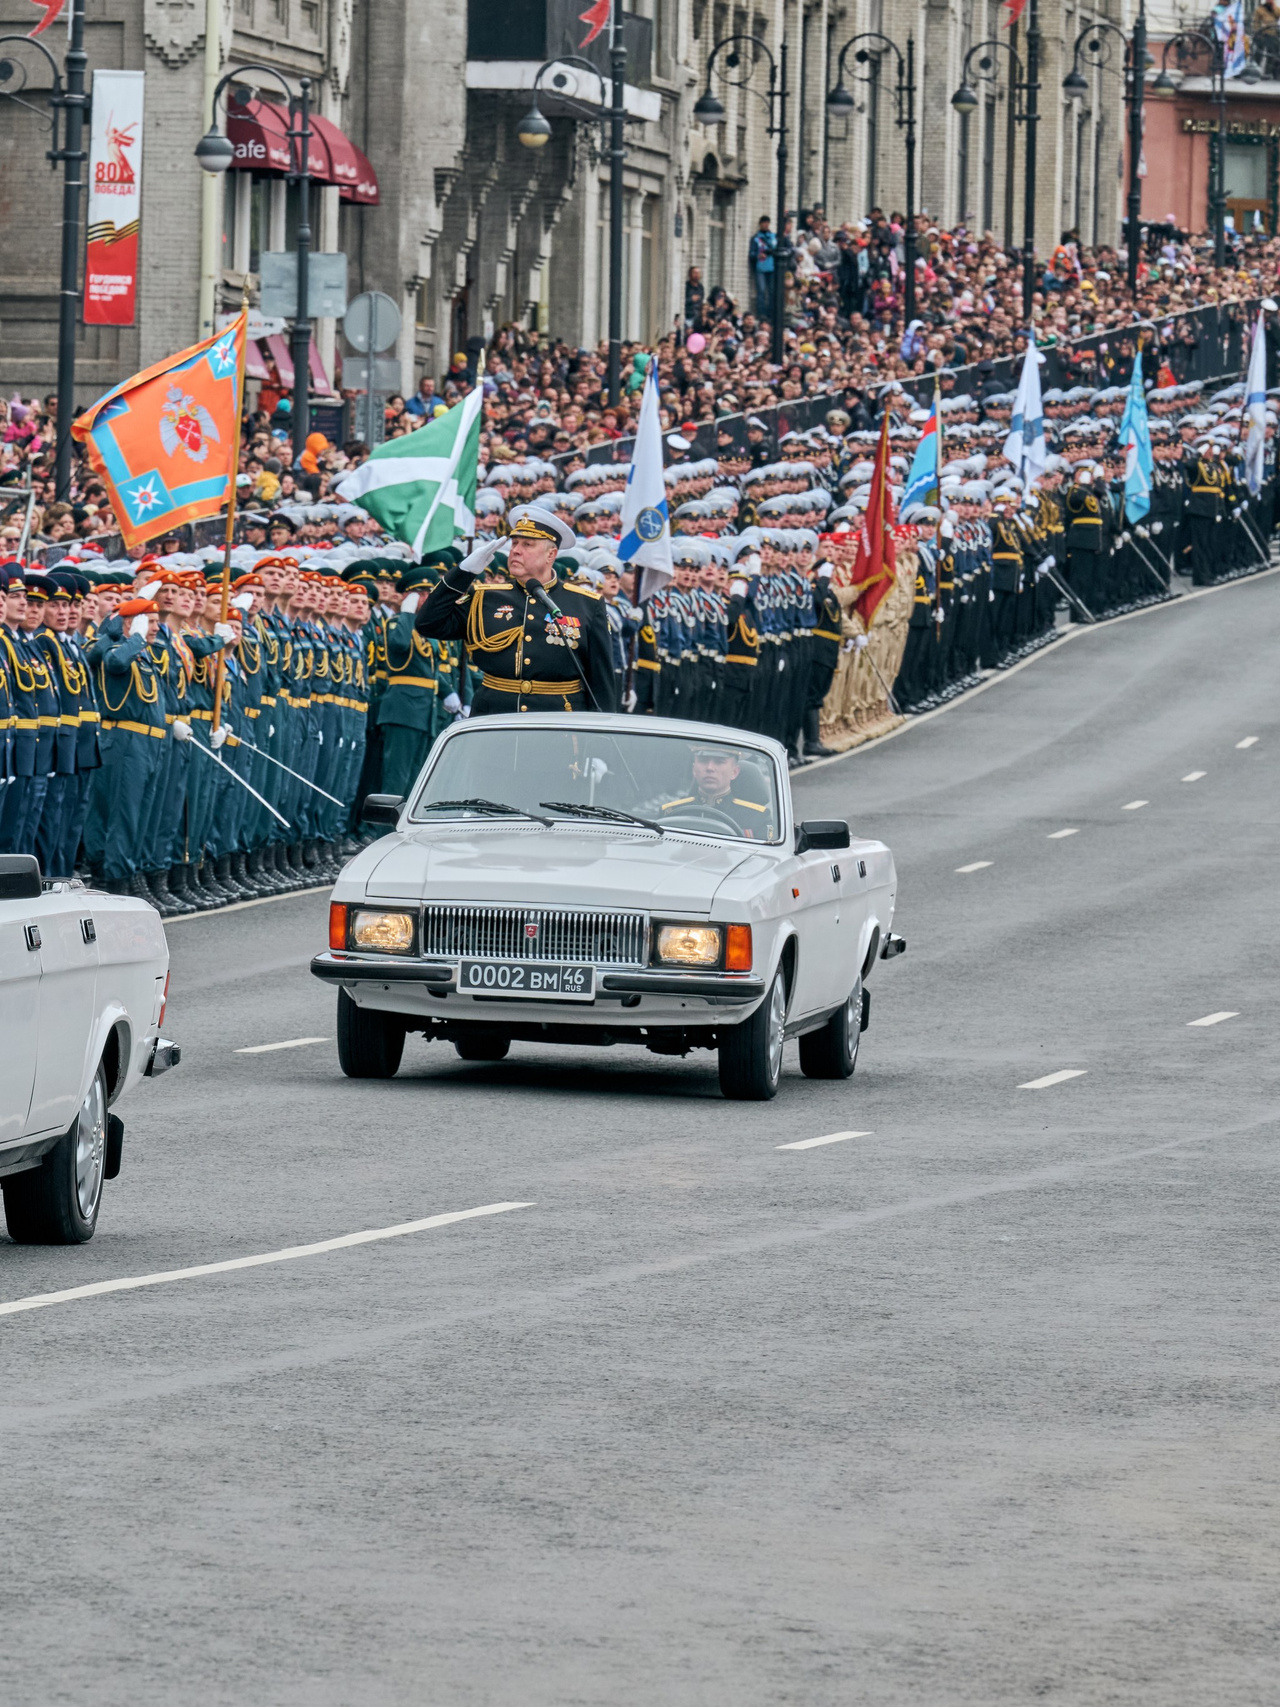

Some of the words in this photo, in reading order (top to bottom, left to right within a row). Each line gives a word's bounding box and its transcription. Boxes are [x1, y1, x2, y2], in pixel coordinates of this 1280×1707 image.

[232, 139, 266, 159] afe
[95, 161, 117, 181] 80
[468, 964, 525, 988] 0002
[562, 968, 585, 985] 46
